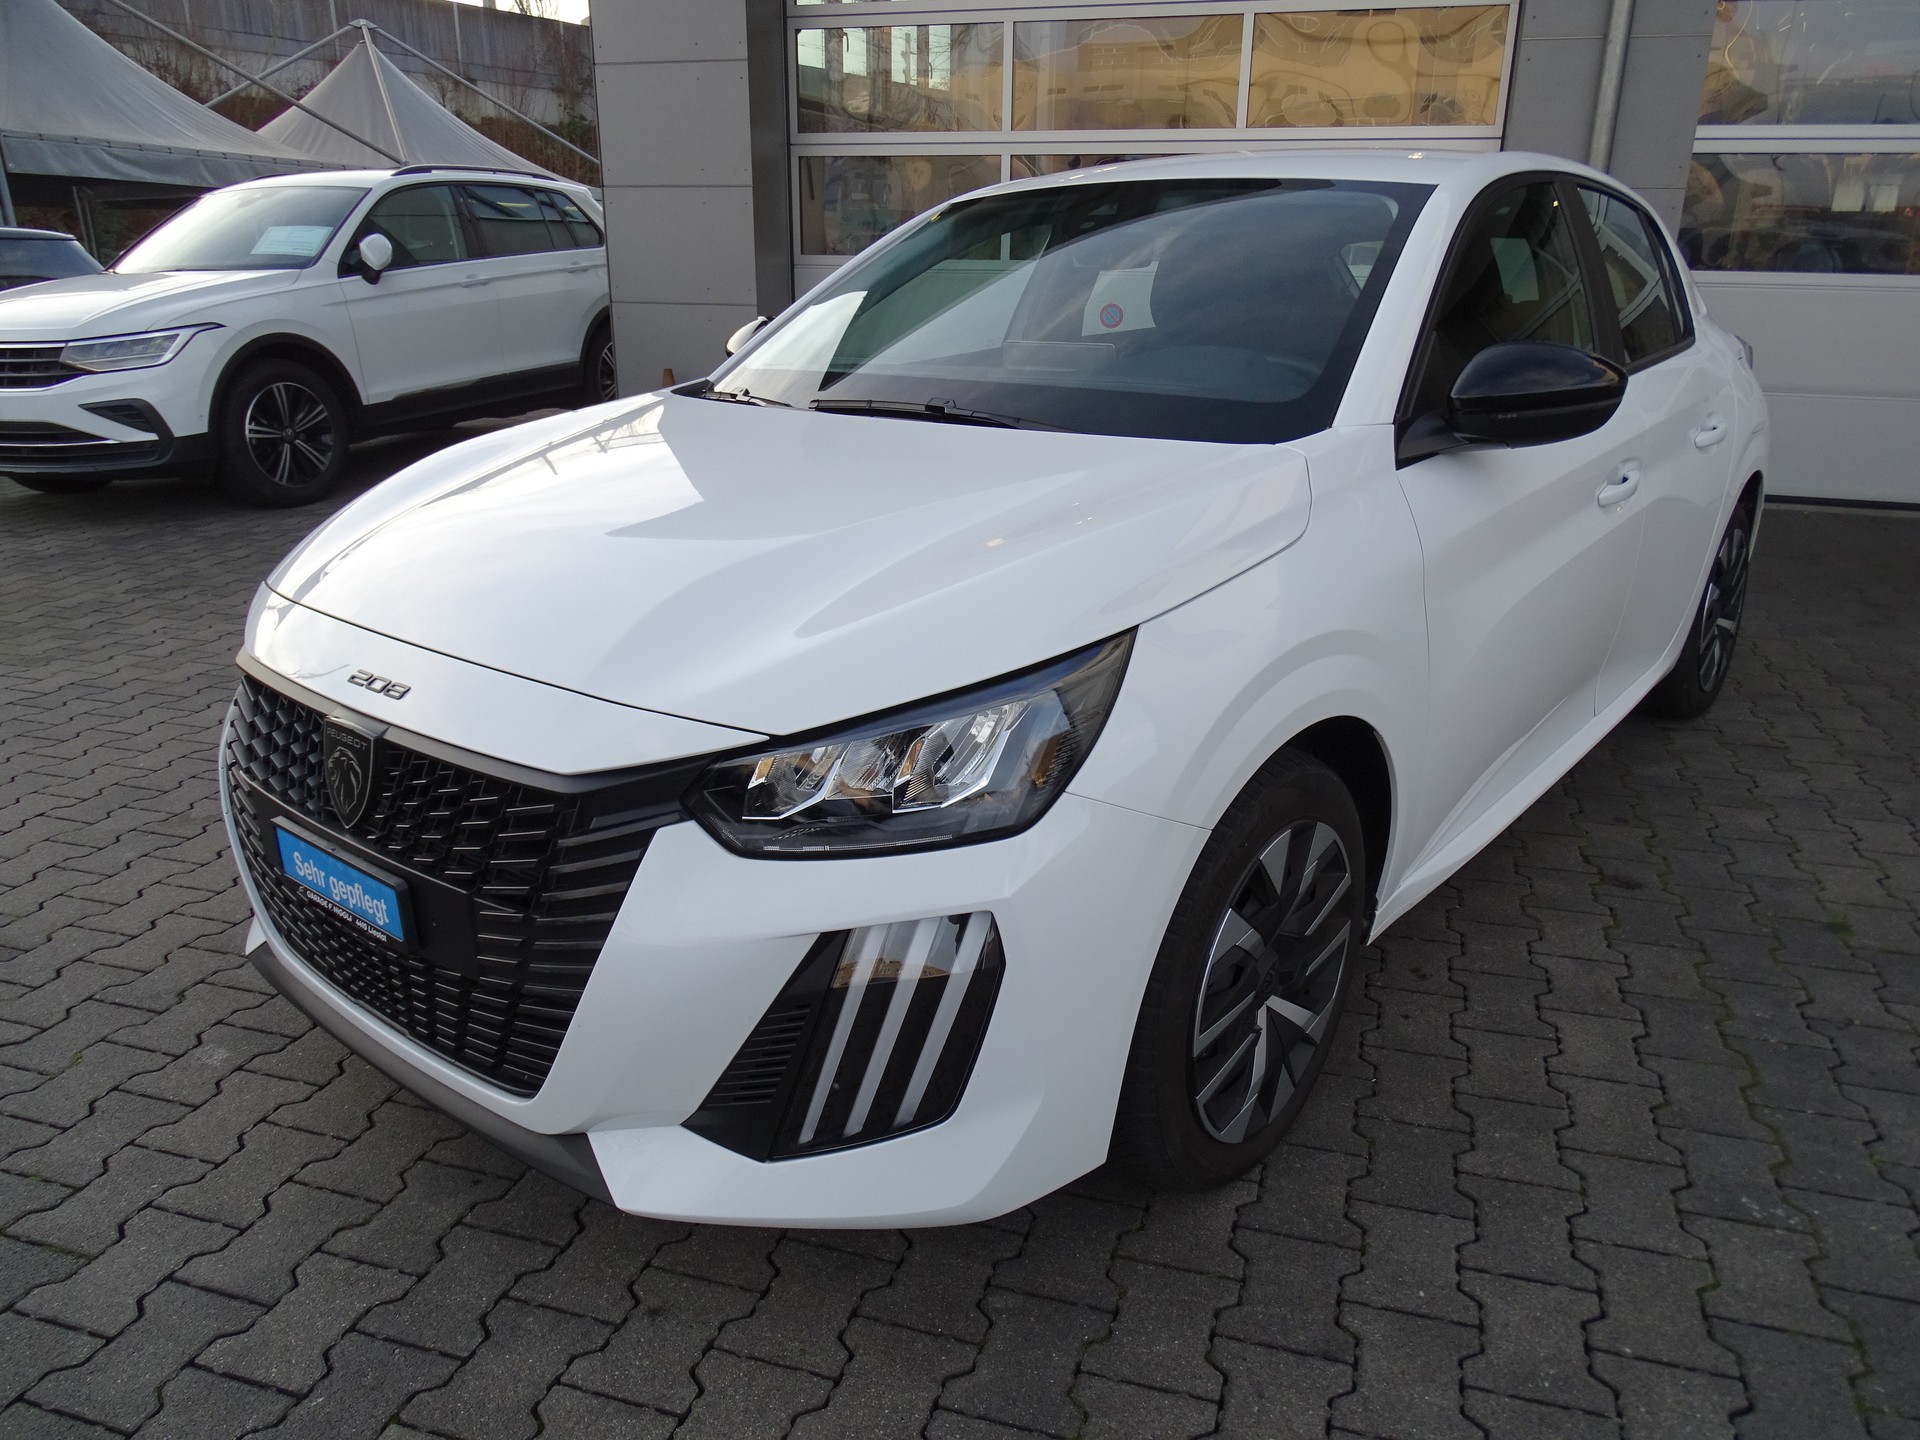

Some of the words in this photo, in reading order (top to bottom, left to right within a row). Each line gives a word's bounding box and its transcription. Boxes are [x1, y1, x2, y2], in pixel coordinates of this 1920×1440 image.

[347, 669, 411, 700] 208
[327, 727, 368, 750] PEUGEOT
[293, 851, 325, 887] Sehr
[329, 876, 389, 926] gepflegt
